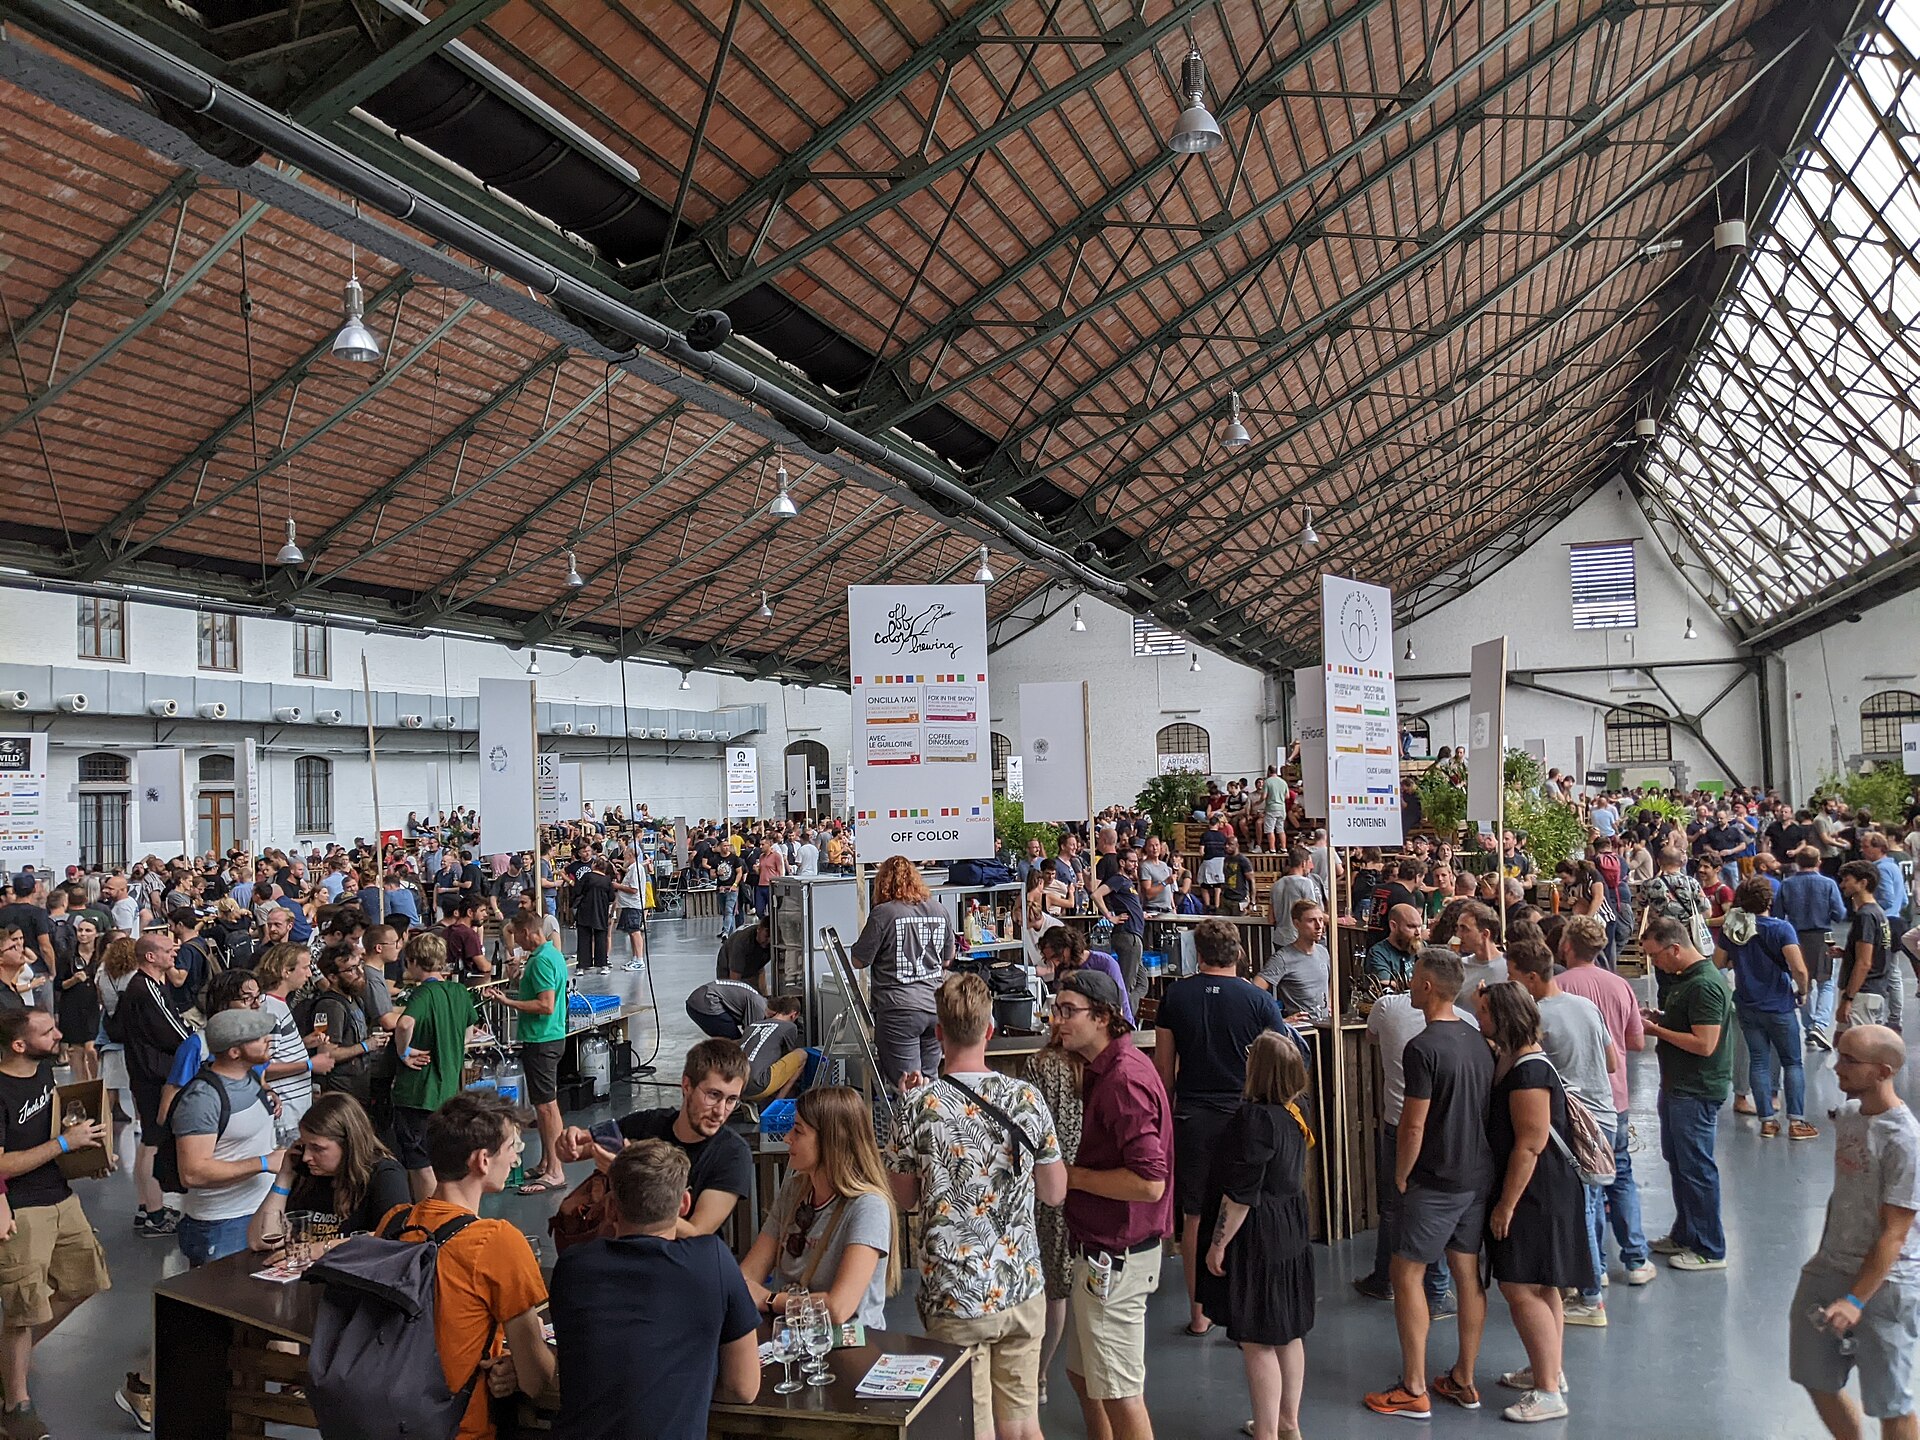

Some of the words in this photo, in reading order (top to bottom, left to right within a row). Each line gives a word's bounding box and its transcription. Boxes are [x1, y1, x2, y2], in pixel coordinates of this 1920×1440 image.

[1356, 590, 1361, 602] 3
[888, 603, 913, 630] off
[874, 620, 909, 643] color
[908, 635, 963, 659] brewing
[867, 696, 899, 704] ONCILLA
[868, 741, 877, 749] LE
[877, 740, 913, 748] GUILLOTINE
[1347, 817, 1352, 828] 3
[1352, 817, 1387, 828] FONTEINEN
[890, 831, 913, 843] OFF
[916, 830, 959, 842] COLOR
